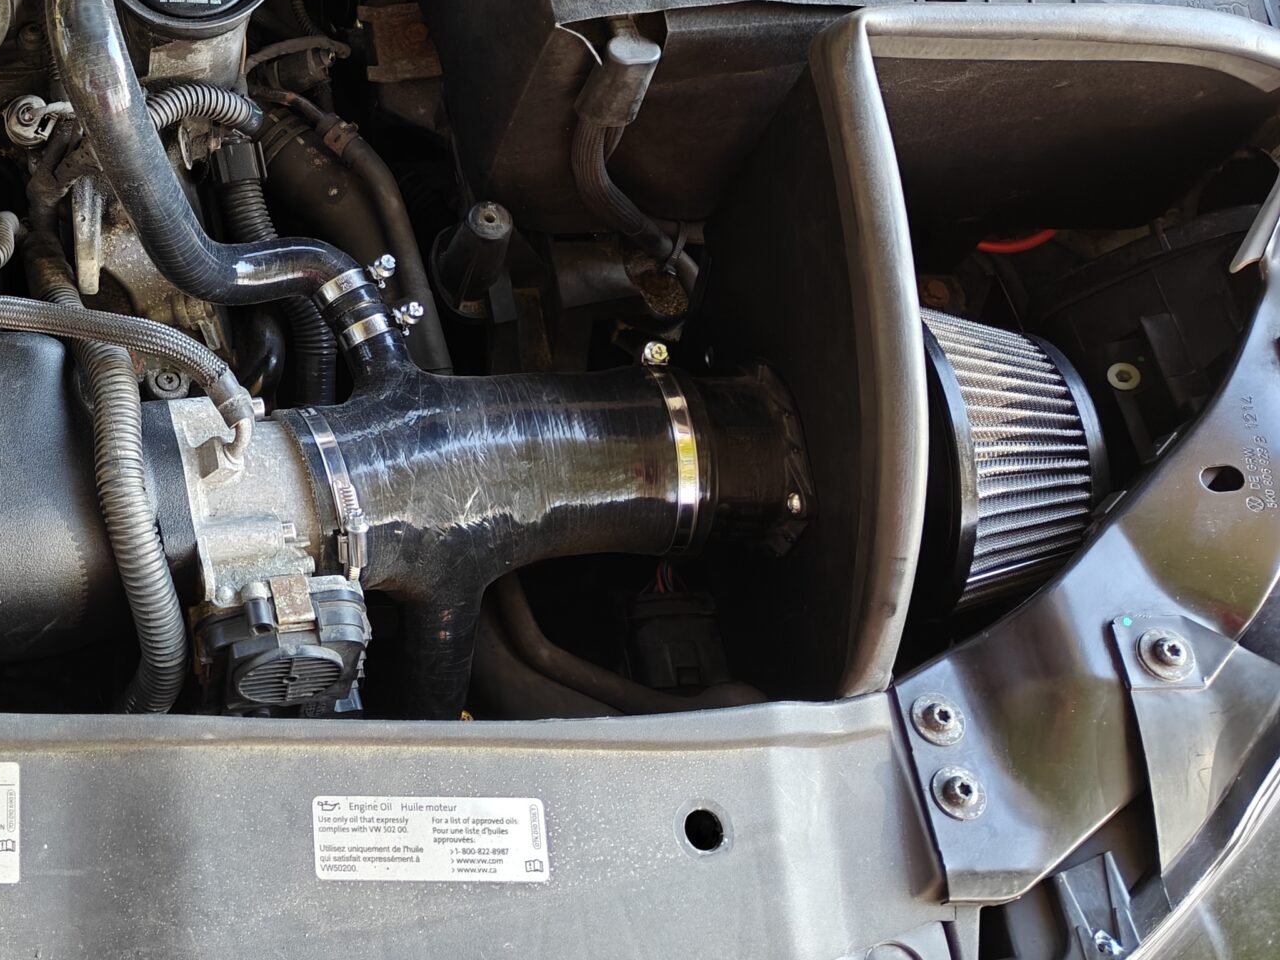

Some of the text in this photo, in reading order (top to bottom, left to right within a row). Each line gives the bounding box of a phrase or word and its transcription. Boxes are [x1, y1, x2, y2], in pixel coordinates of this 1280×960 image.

[349, 802, 457, 814] Engine Oil Huile moteur
[332, 816, 348, 825] only
[376, 816, 409, 826] expressly
[472, 817, 504, 826] approved
[318, 826, 350, 834] complies
[432, 827, 449, 835] Pour
[465, 827, 480, 835] liste
[319, 844, 346, 852] Utilisez
[347, 845, 390, 855] uniquement
[391, 845, 402, 853] de
[320, 855, 331, 863] qui
[362, 855, 414, 863] expressément
